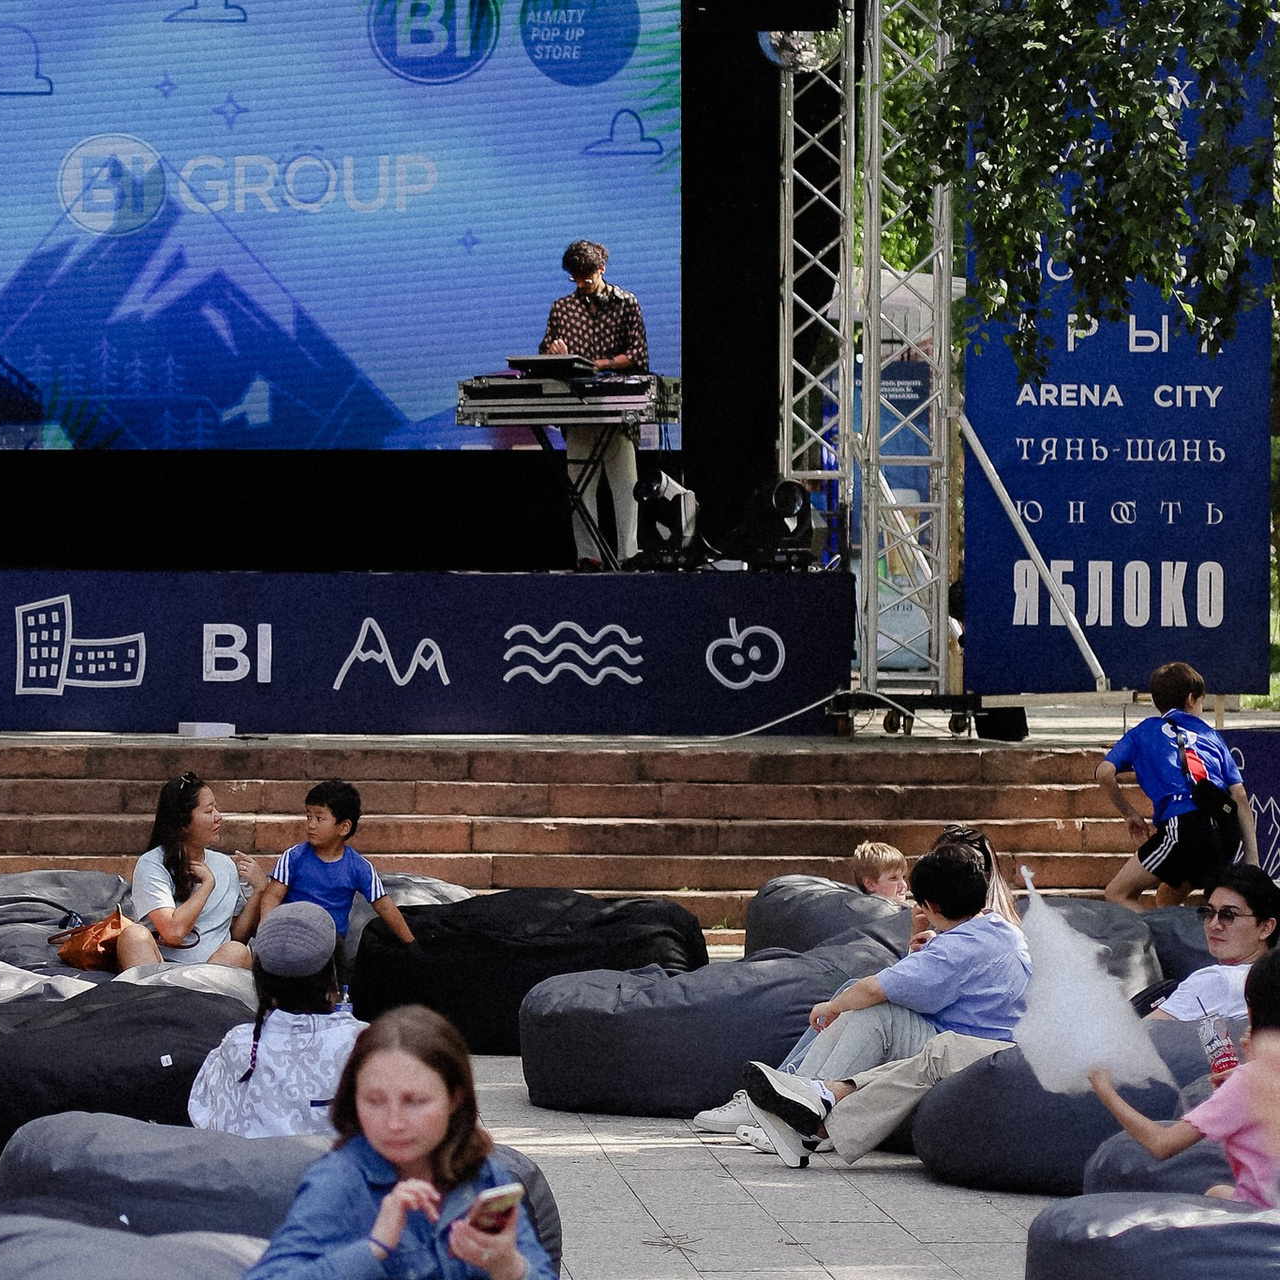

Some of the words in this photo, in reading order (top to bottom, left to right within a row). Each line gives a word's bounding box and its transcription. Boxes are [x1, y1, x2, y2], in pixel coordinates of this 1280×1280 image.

[527, 9, 586, 24] ALMATY
[531, 27, 560, 41] POP
[565, 27, 585, 41] UP
[534, 45, 581, 59] STORE
[178, 154, 438, 214] GROUP
[1016, 383, 1124, 407] ARENA
[1153, 385, 1224, 408] CITY
[1015, 437, 1227, 465] ТЯНЬ-ШАНЬ
[1012, 559, 1225, 628] ЯБЛОКО
[202, 623, 272, 683] BI
